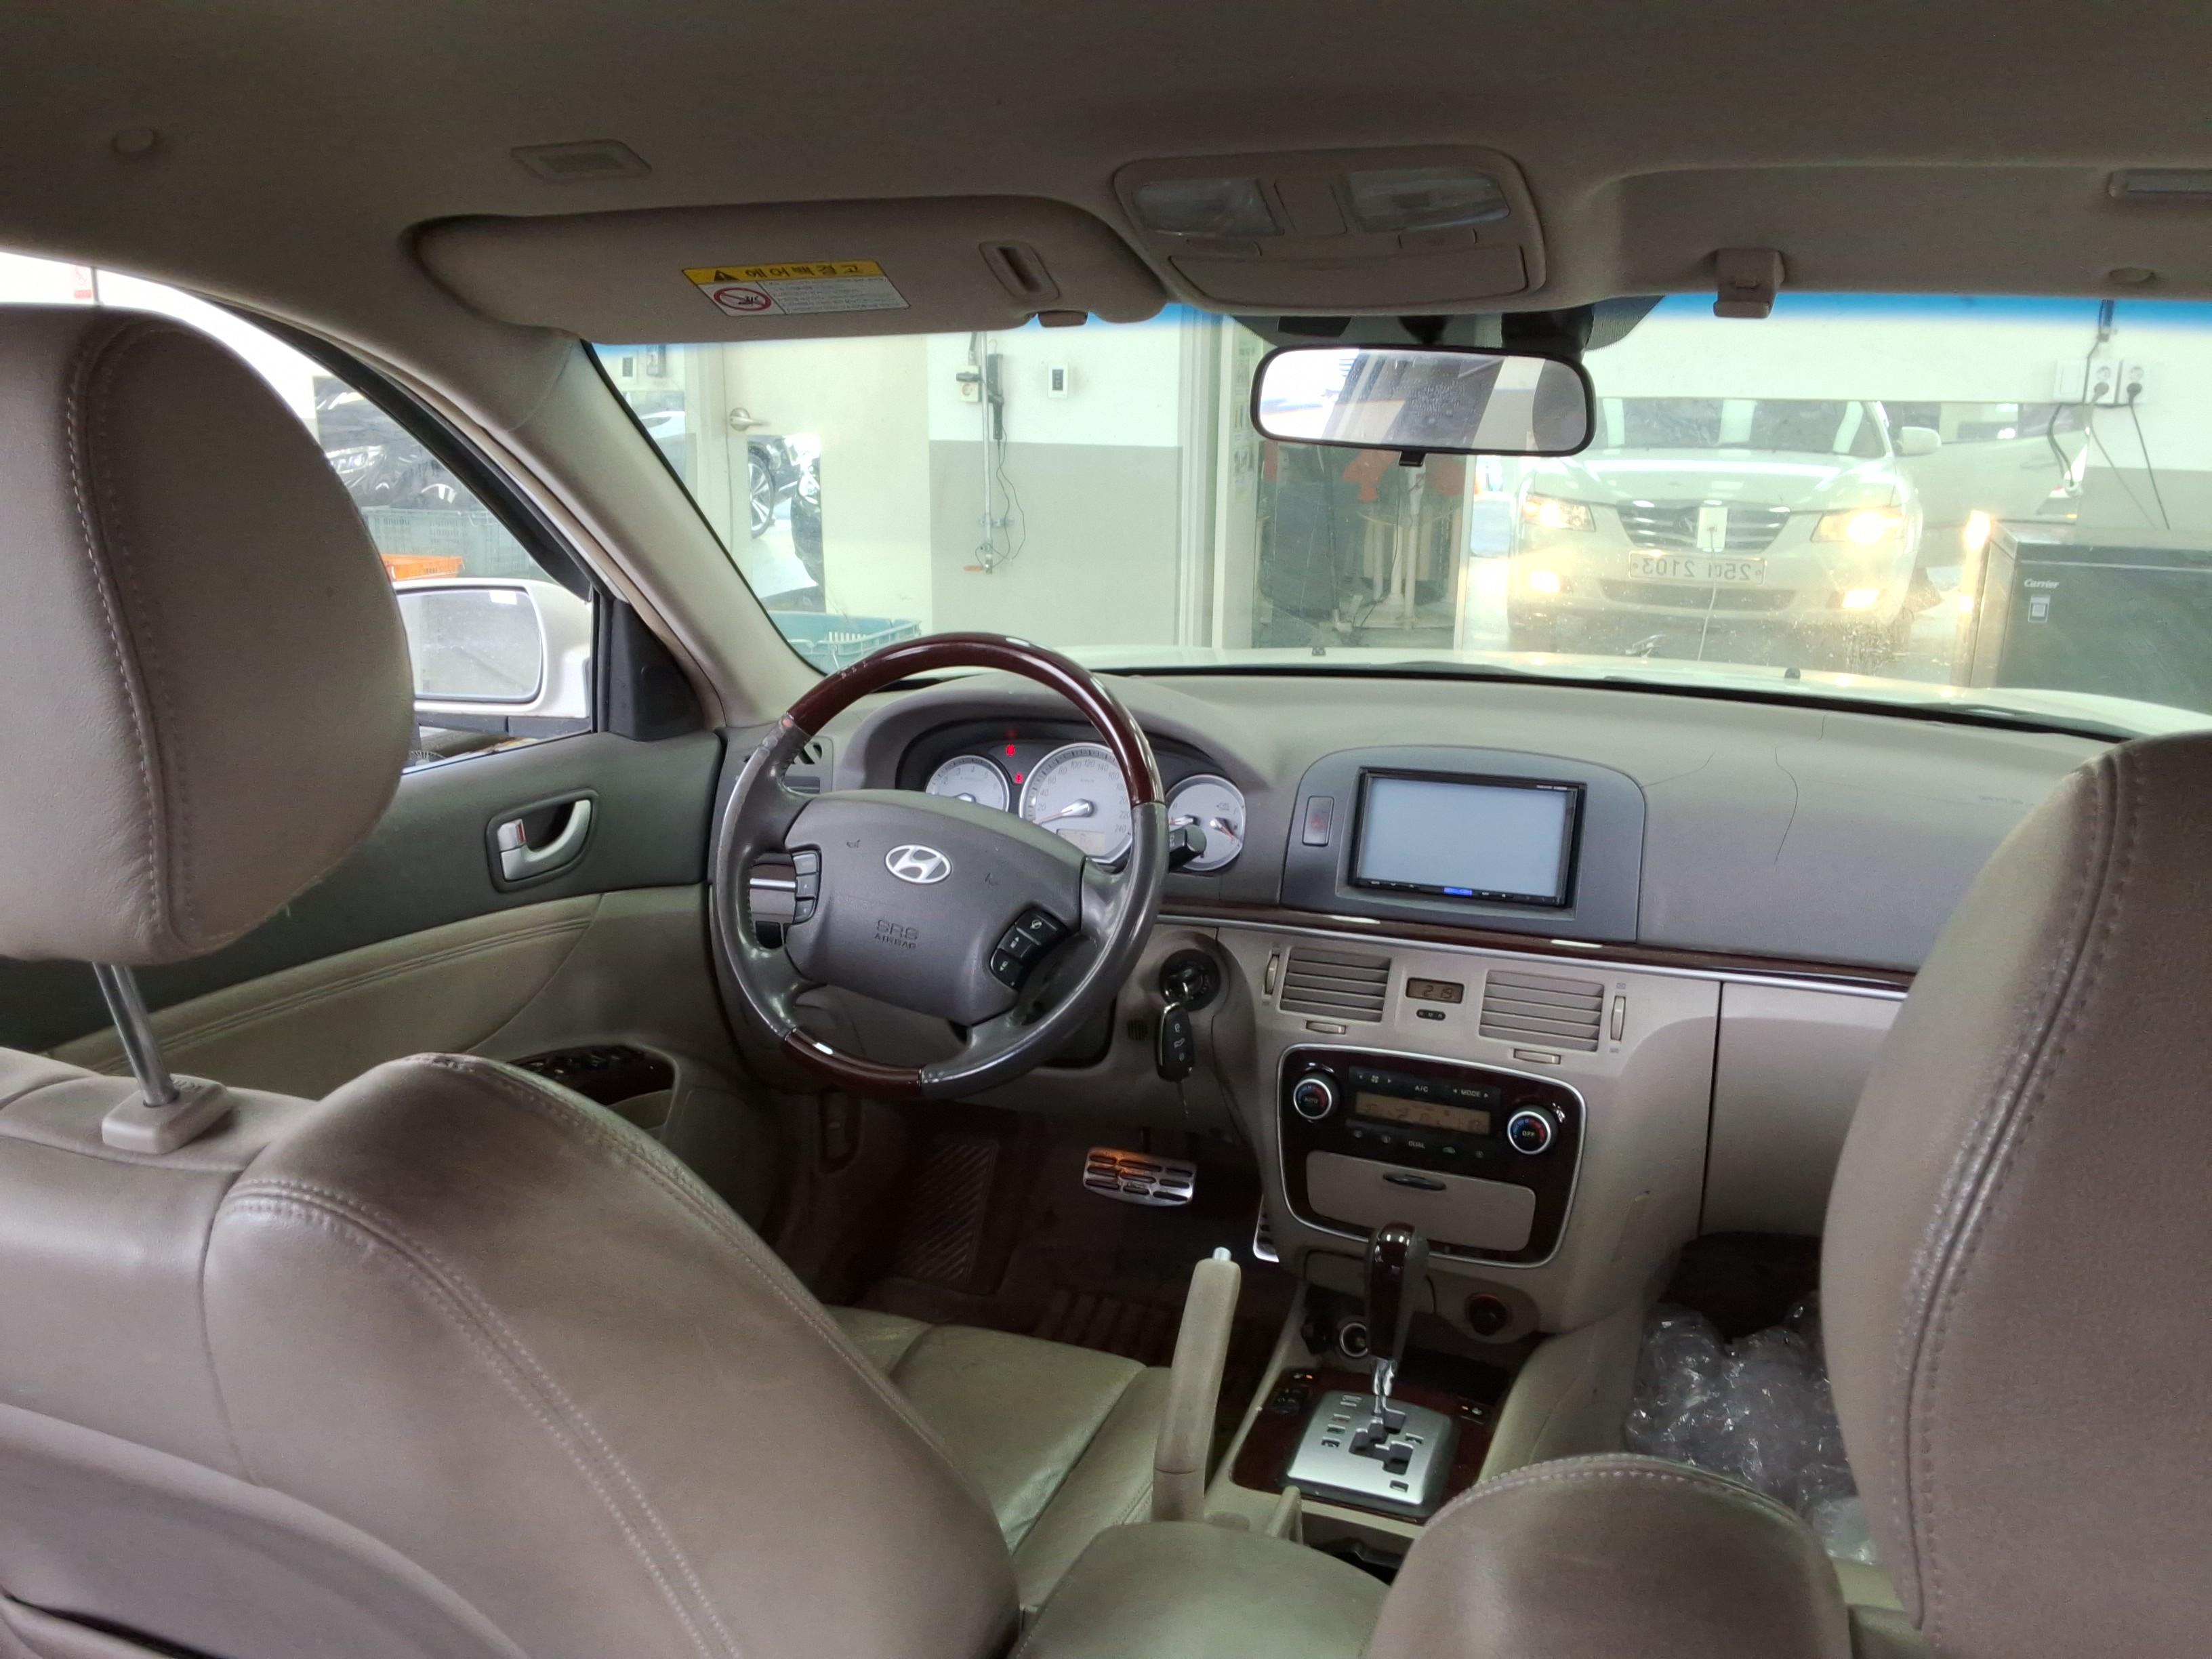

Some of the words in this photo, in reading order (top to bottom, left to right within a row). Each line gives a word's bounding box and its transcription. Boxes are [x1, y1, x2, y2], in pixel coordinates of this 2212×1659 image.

[2024, 578, 2060, 589] Carrier
[877, 919, 919, 941] SRS
[1414, 1085, 1429, 1093] A/C
[1460, 1089, 1481, 1098] MODE
[1521, 1130, 1536, 1138] OFF
